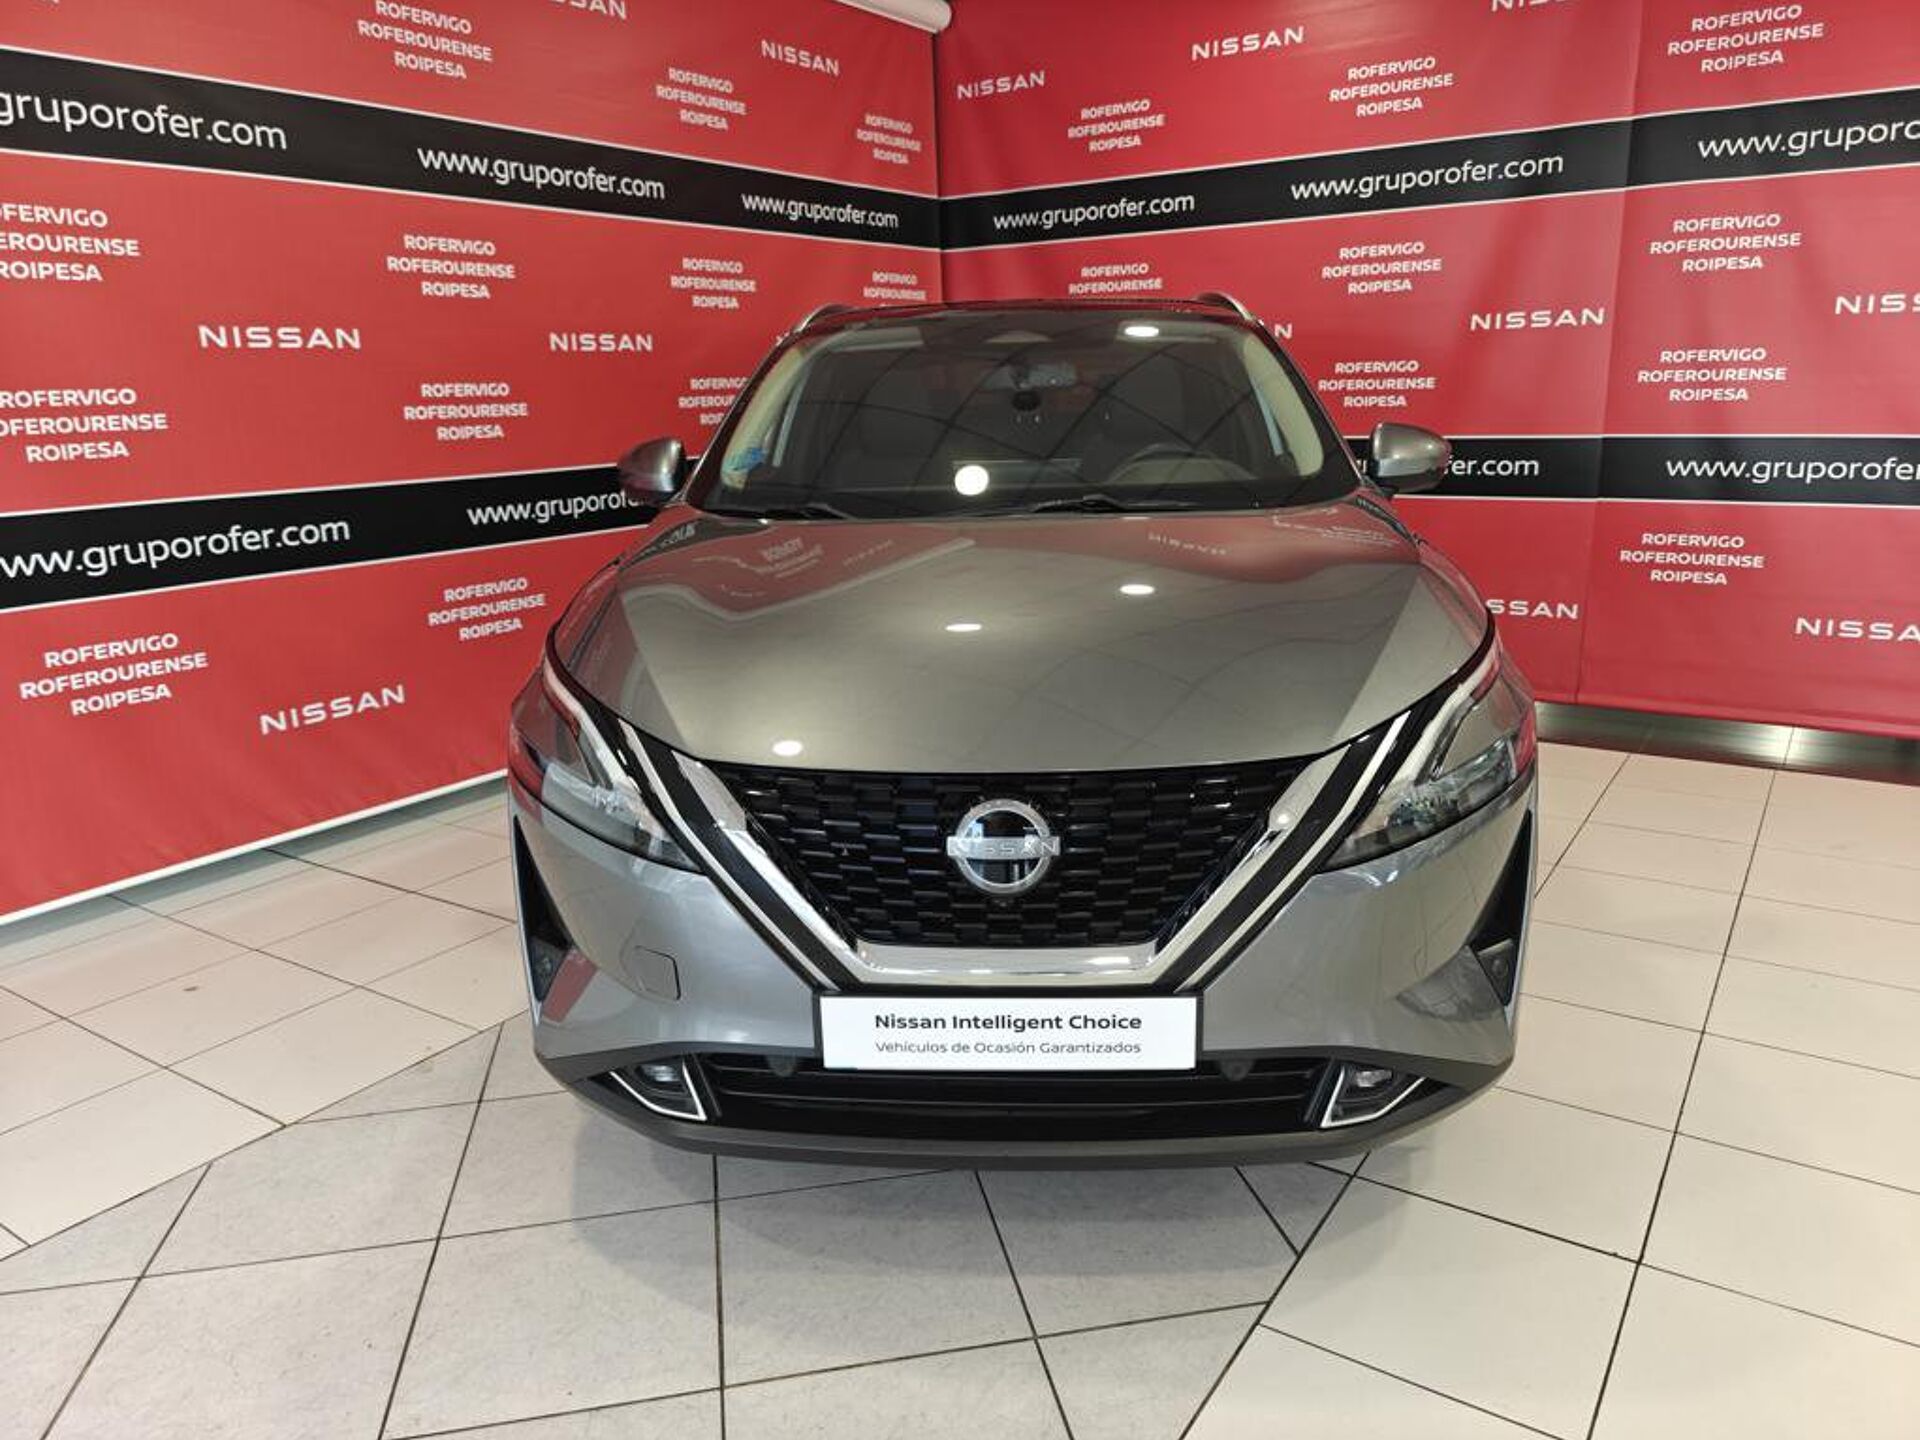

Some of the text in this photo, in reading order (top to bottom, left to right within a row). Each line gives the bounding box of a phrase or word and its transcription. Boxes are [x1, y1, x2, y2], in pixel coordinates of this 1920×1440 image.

[375, 0, 472, 35] ROFERVIGO
[1691, 4, 1803, 32] ROFERVIGO
[357, 19, 493, 62] ROFEROURENSE
[1192, 25, 1305, 61] NISSAN
[1667, 22, 1824, 55] ROFEROURENSE
[394, 50, 467, 79] ROIPESA
[761, 39, 839, 76] NISSAN
[1347, 56, 1436, 81] ROFERVIGO
[1701, 49, 1784, 73] ROIPESA
[957, 70, 1045, 100] NISSAN
[1329, 72, 1453, 102] ROFEROURENSE
[1080, 98, 1151, 120] ROFERVIGO
[1356, 96, 1423, 117] ROIPESA
[1067, 113, 1165, 138] ROFEROURENSE
[1089, 134, 1142, 152] ROIPESA
[417, 147, 665, 199] www.gruporofer.com
[1290, 155, 1564, 200] www.gruporofer.com
[0, 202, 108, 228] FERVIGO
[741, 194, 899, 228] www.gruporofer.com
[993, 194, 1195, 230] www.gruporofer.com
[1673, 213, 1781, 233] ROFERVIGO
[403, 234, 496, 256] ROFERVIGO
[1338, 241, 1425, 260] ROFERVIGO
[1650, 232, 1802, 255] ROFEROURENSE
[386, 255, 515, 279] ROFEROURENSE
[1080, 262, 1150, 278] ROFERVIGO
[1321, 258, 1442, 279] ROFEROURENSE
[1682, 255, 1764, 272] ROIPESA
[421, 281, 491, 299] ROIPESA
[1068, 277, 1163, 294] ROFEROURENSE
[1347, 278, 1413, 294] ROIPESA
[1470, 307, 1605, 331] NISSAN
[198, 325, 361, 349] NISSAN
[549, 332, 653, 352] NISSAN
[1659, 346, 1767, 363] ROFERVIGO
[1334, 359, 1420, 374] ROFERVIGO
[1637, 366, 1788, 383] ROFEROURENSE
[420, 382, 510, 398] ROFERVIGO
[1318, 376, 1436, 391] ROFEROURENSE
[1669, 387, 1749, 402] ROIPESA
[403, 402, 528, 420] ROFEROURENSE
[1343, 394, 1407, 408] ROIPESA
[436, 424, 505, 441] ROIPESA
[25, 441, 130, 463] ROIPESA
[1641, 533, 1745, 549] ROFERVIGO
[1620, 550, 1765, 569] ROFEROURENSE
[1650, 569, 1728, 585] ROIPESA
[443, 577, 528, 603] ROFERVIGO
[427, 593, 545, 627] ROFEROURENSE
[1485, 598, 1579, 620] SSAN
[459, 617, 523, 641] ROIPESA
[44, 633, 179, 668] ROFERVIGO
[19, 652, 208, 699] ROFEROURENSE
[70, 683, 172, 716] ROIPESA
[259, 684, 405, 735] NISSAN
[874, 1013, 1142, 1033] Nissan Intelligent Choice
[874, 1040, 1142, 1054] Vehículos de Ocasión Garantizados
